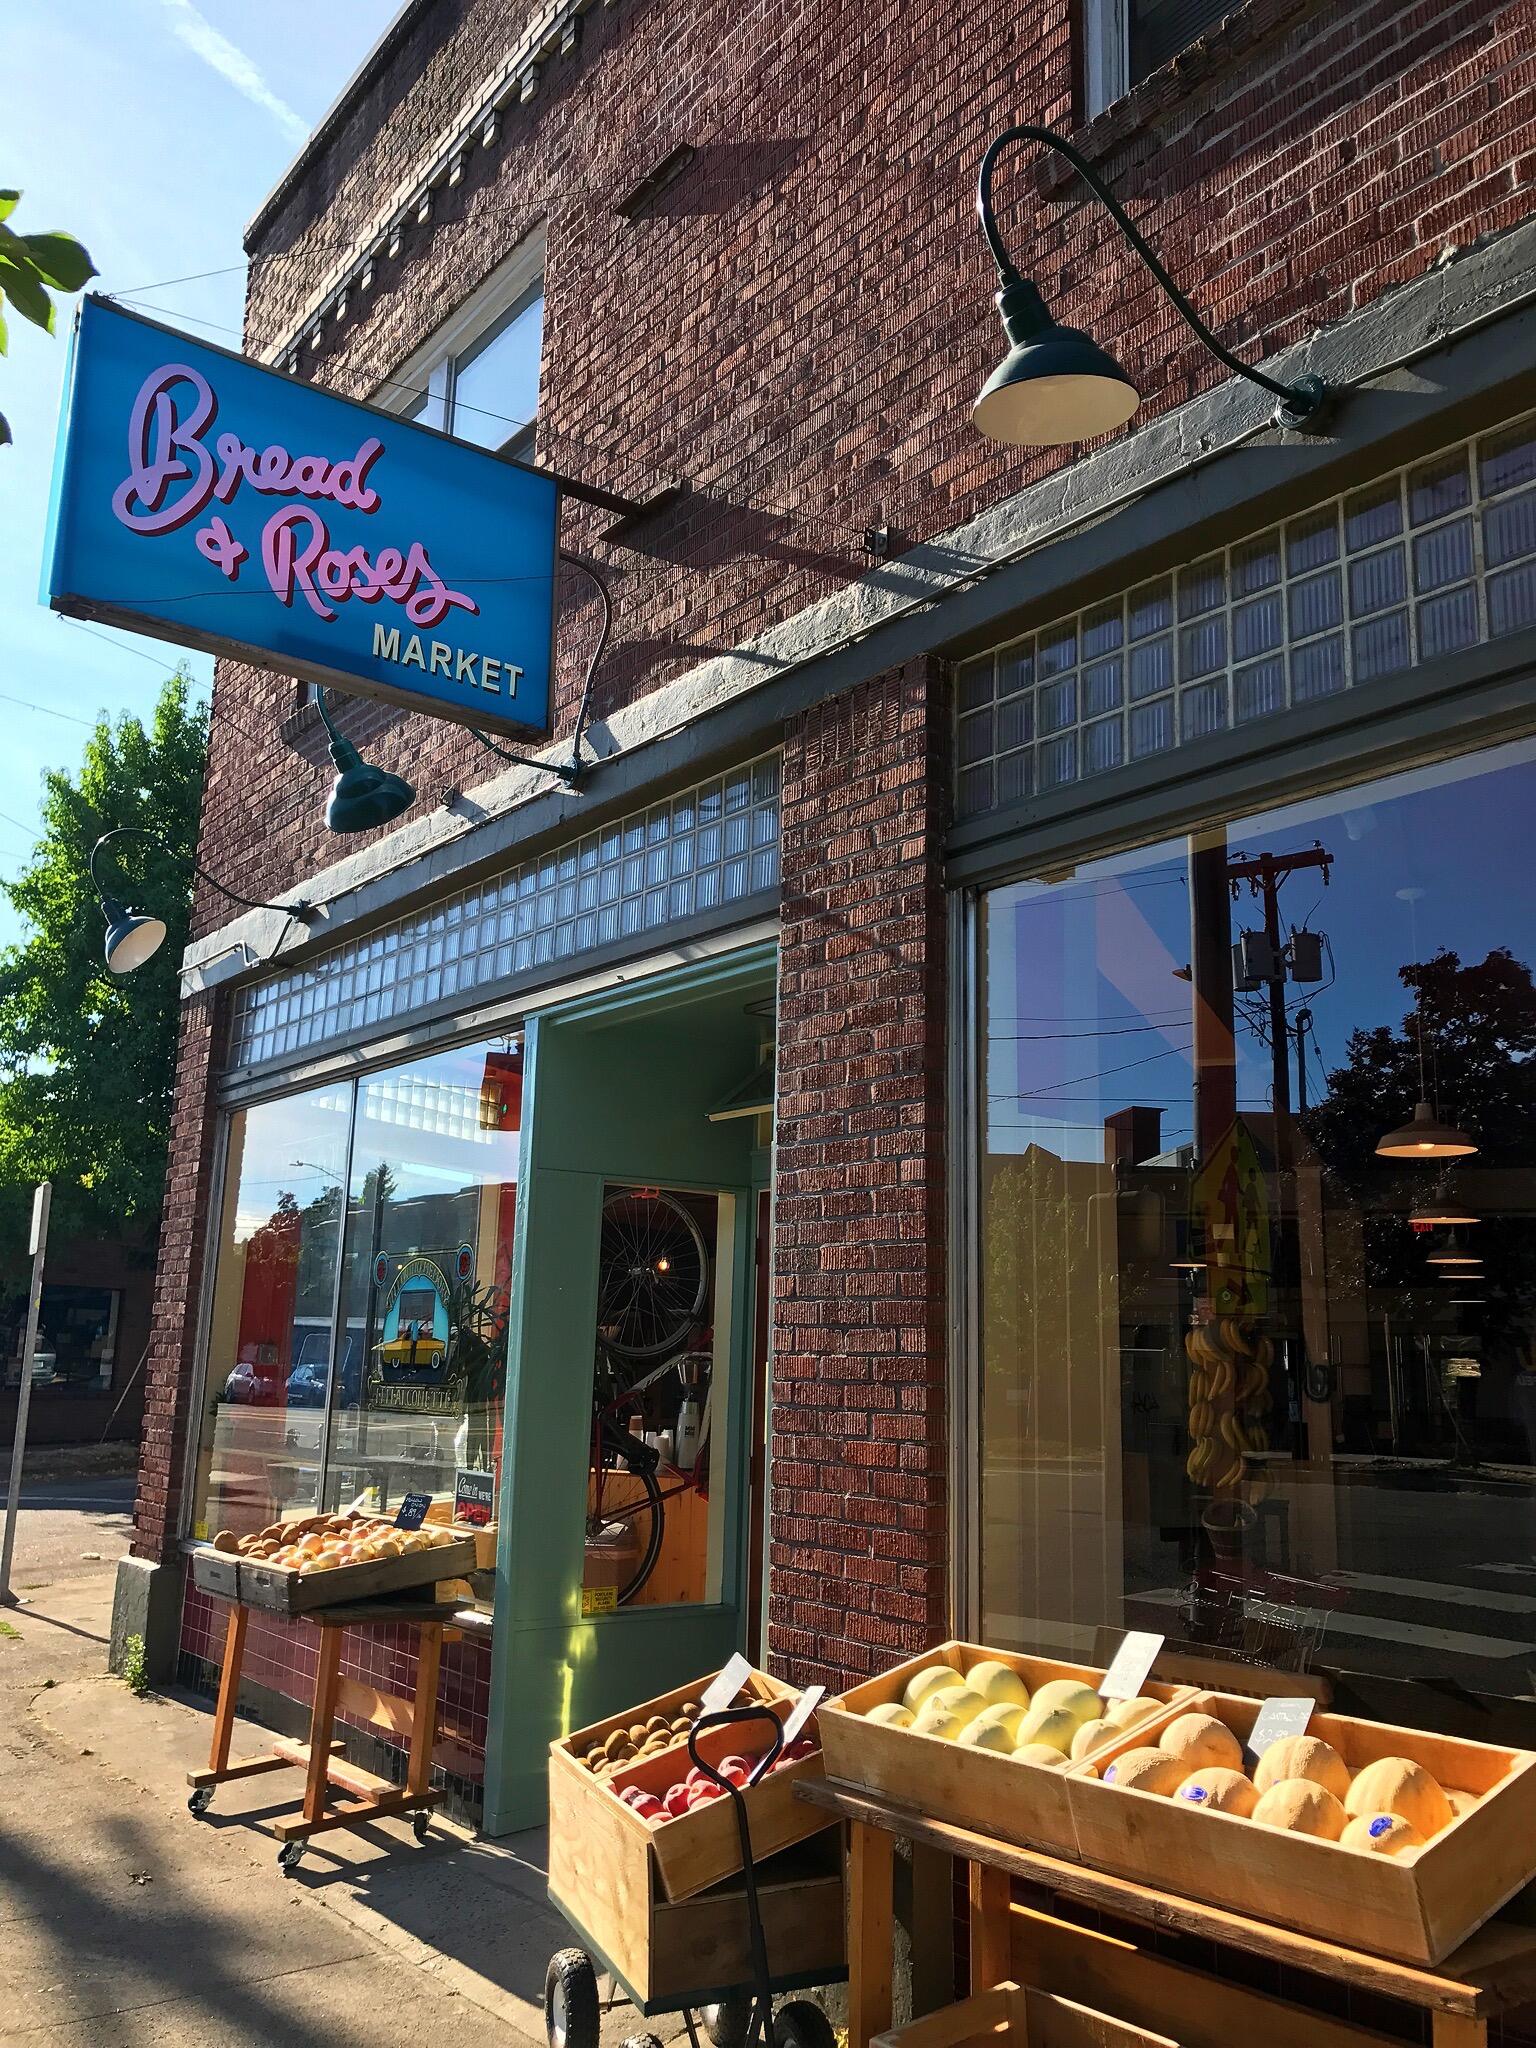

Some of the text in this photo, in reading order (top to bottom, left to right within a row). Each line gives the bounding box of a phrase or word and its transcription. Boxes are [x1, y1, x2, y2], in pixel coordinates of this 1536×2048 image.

[112, 363, 384, 536] Bread
[195, 504, 480, 628] & Roses
[372, 623, 524, 699] MARKET
